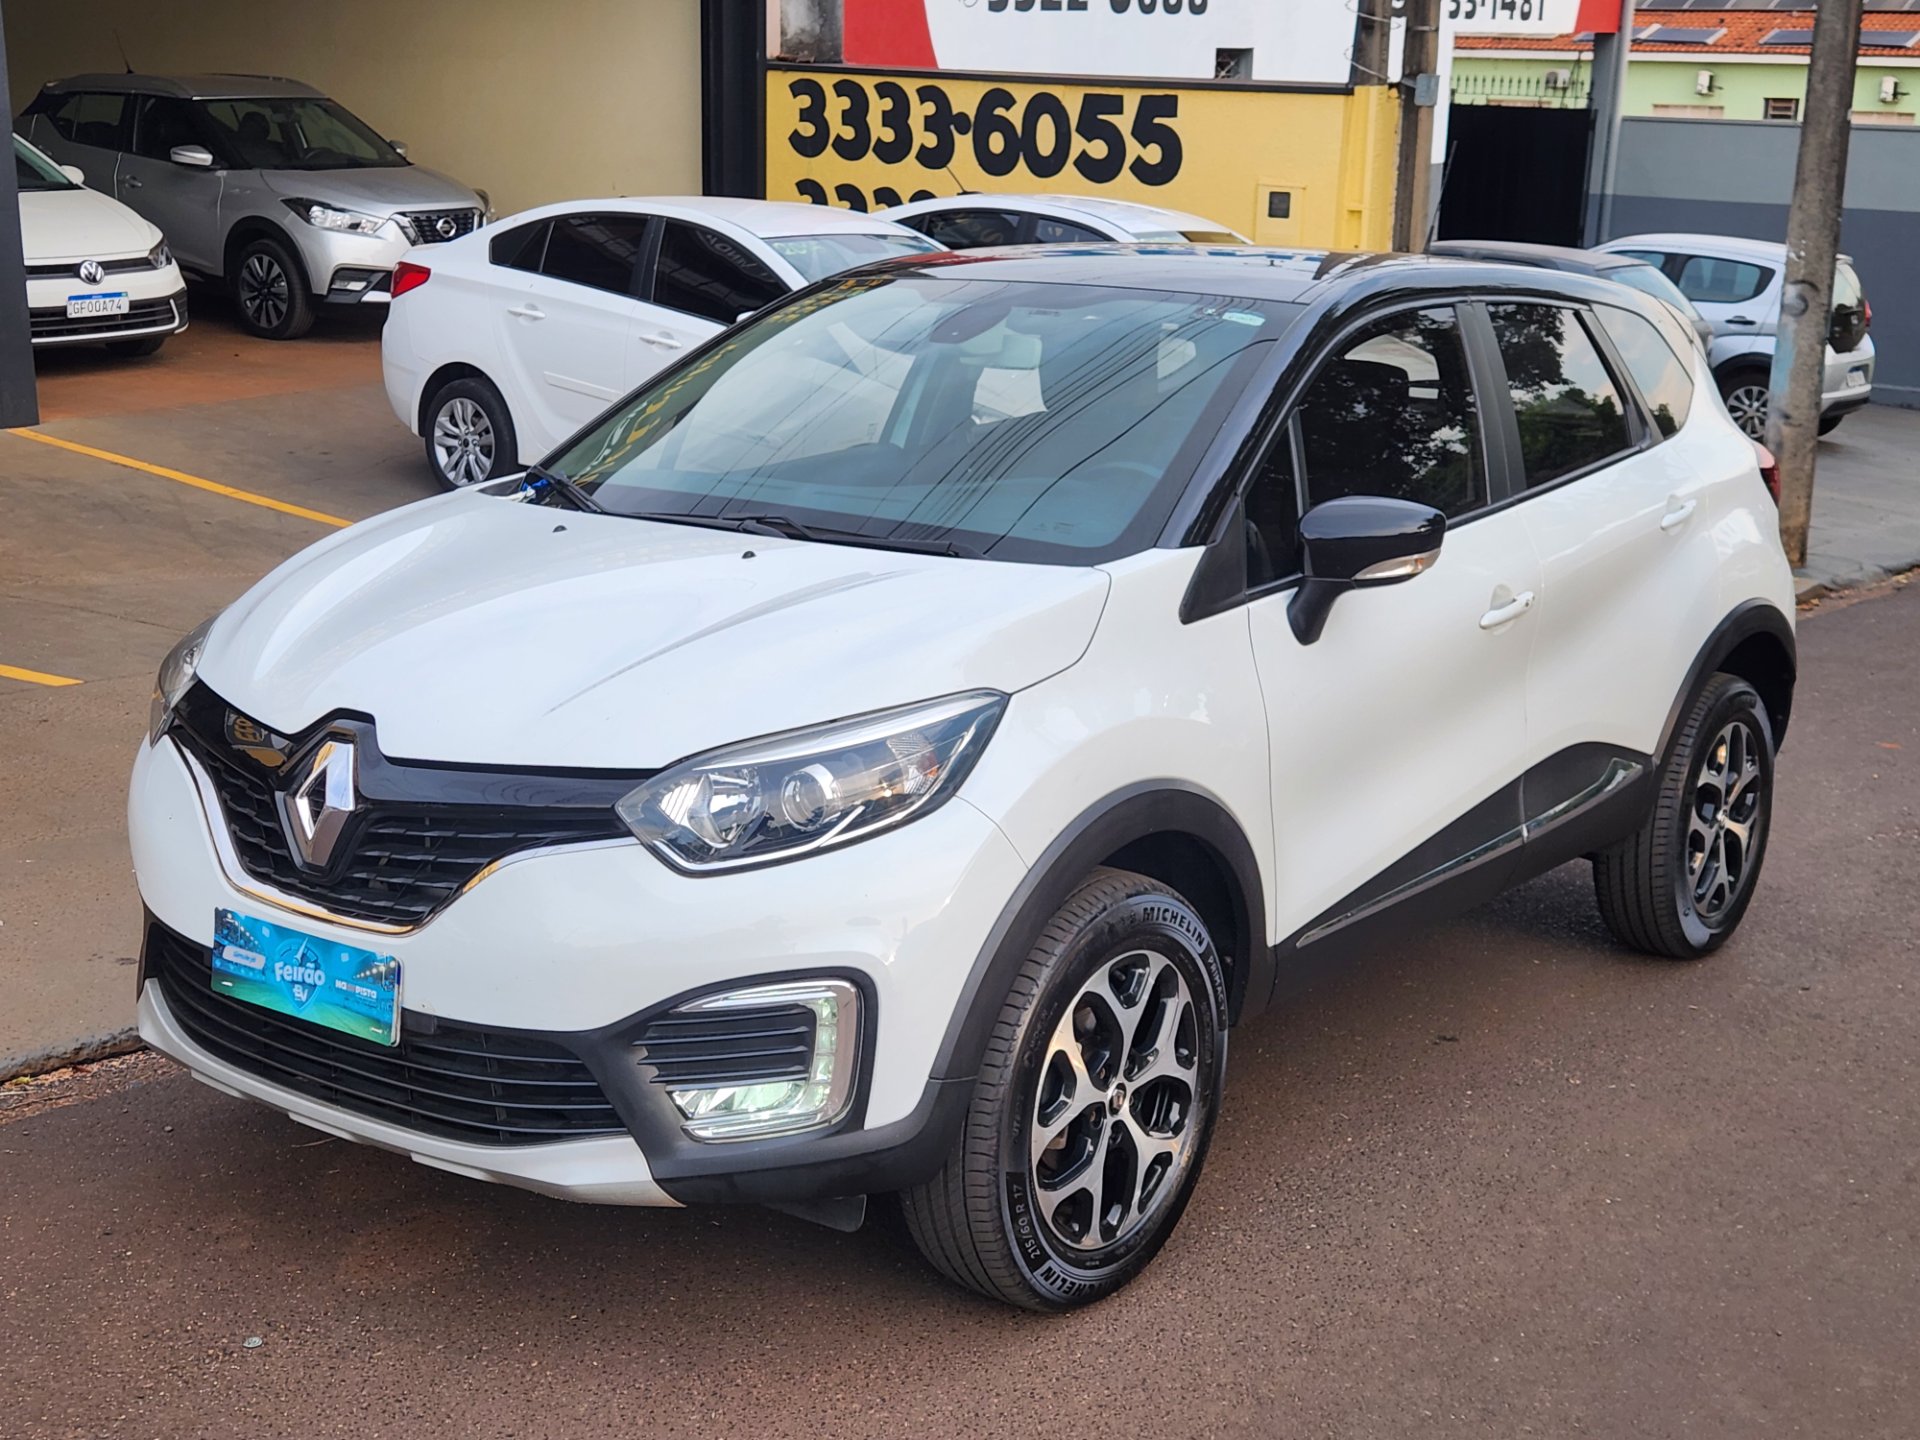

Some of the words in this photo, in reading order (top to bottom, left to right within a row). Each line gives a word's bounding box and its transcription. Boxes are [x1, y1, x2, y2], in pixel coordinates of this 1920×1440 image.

[1142, 906, 1206, 948] MICHELIN
[274, 961, 326, 986] Feirão
[1207, 955, 1225, 1010] PRIMACY
[1013, 1184, 1023, 1199] 17
[1016, 1203, 1025, 1213] R
[1018, 1218, 1041, 1259] 215/60
